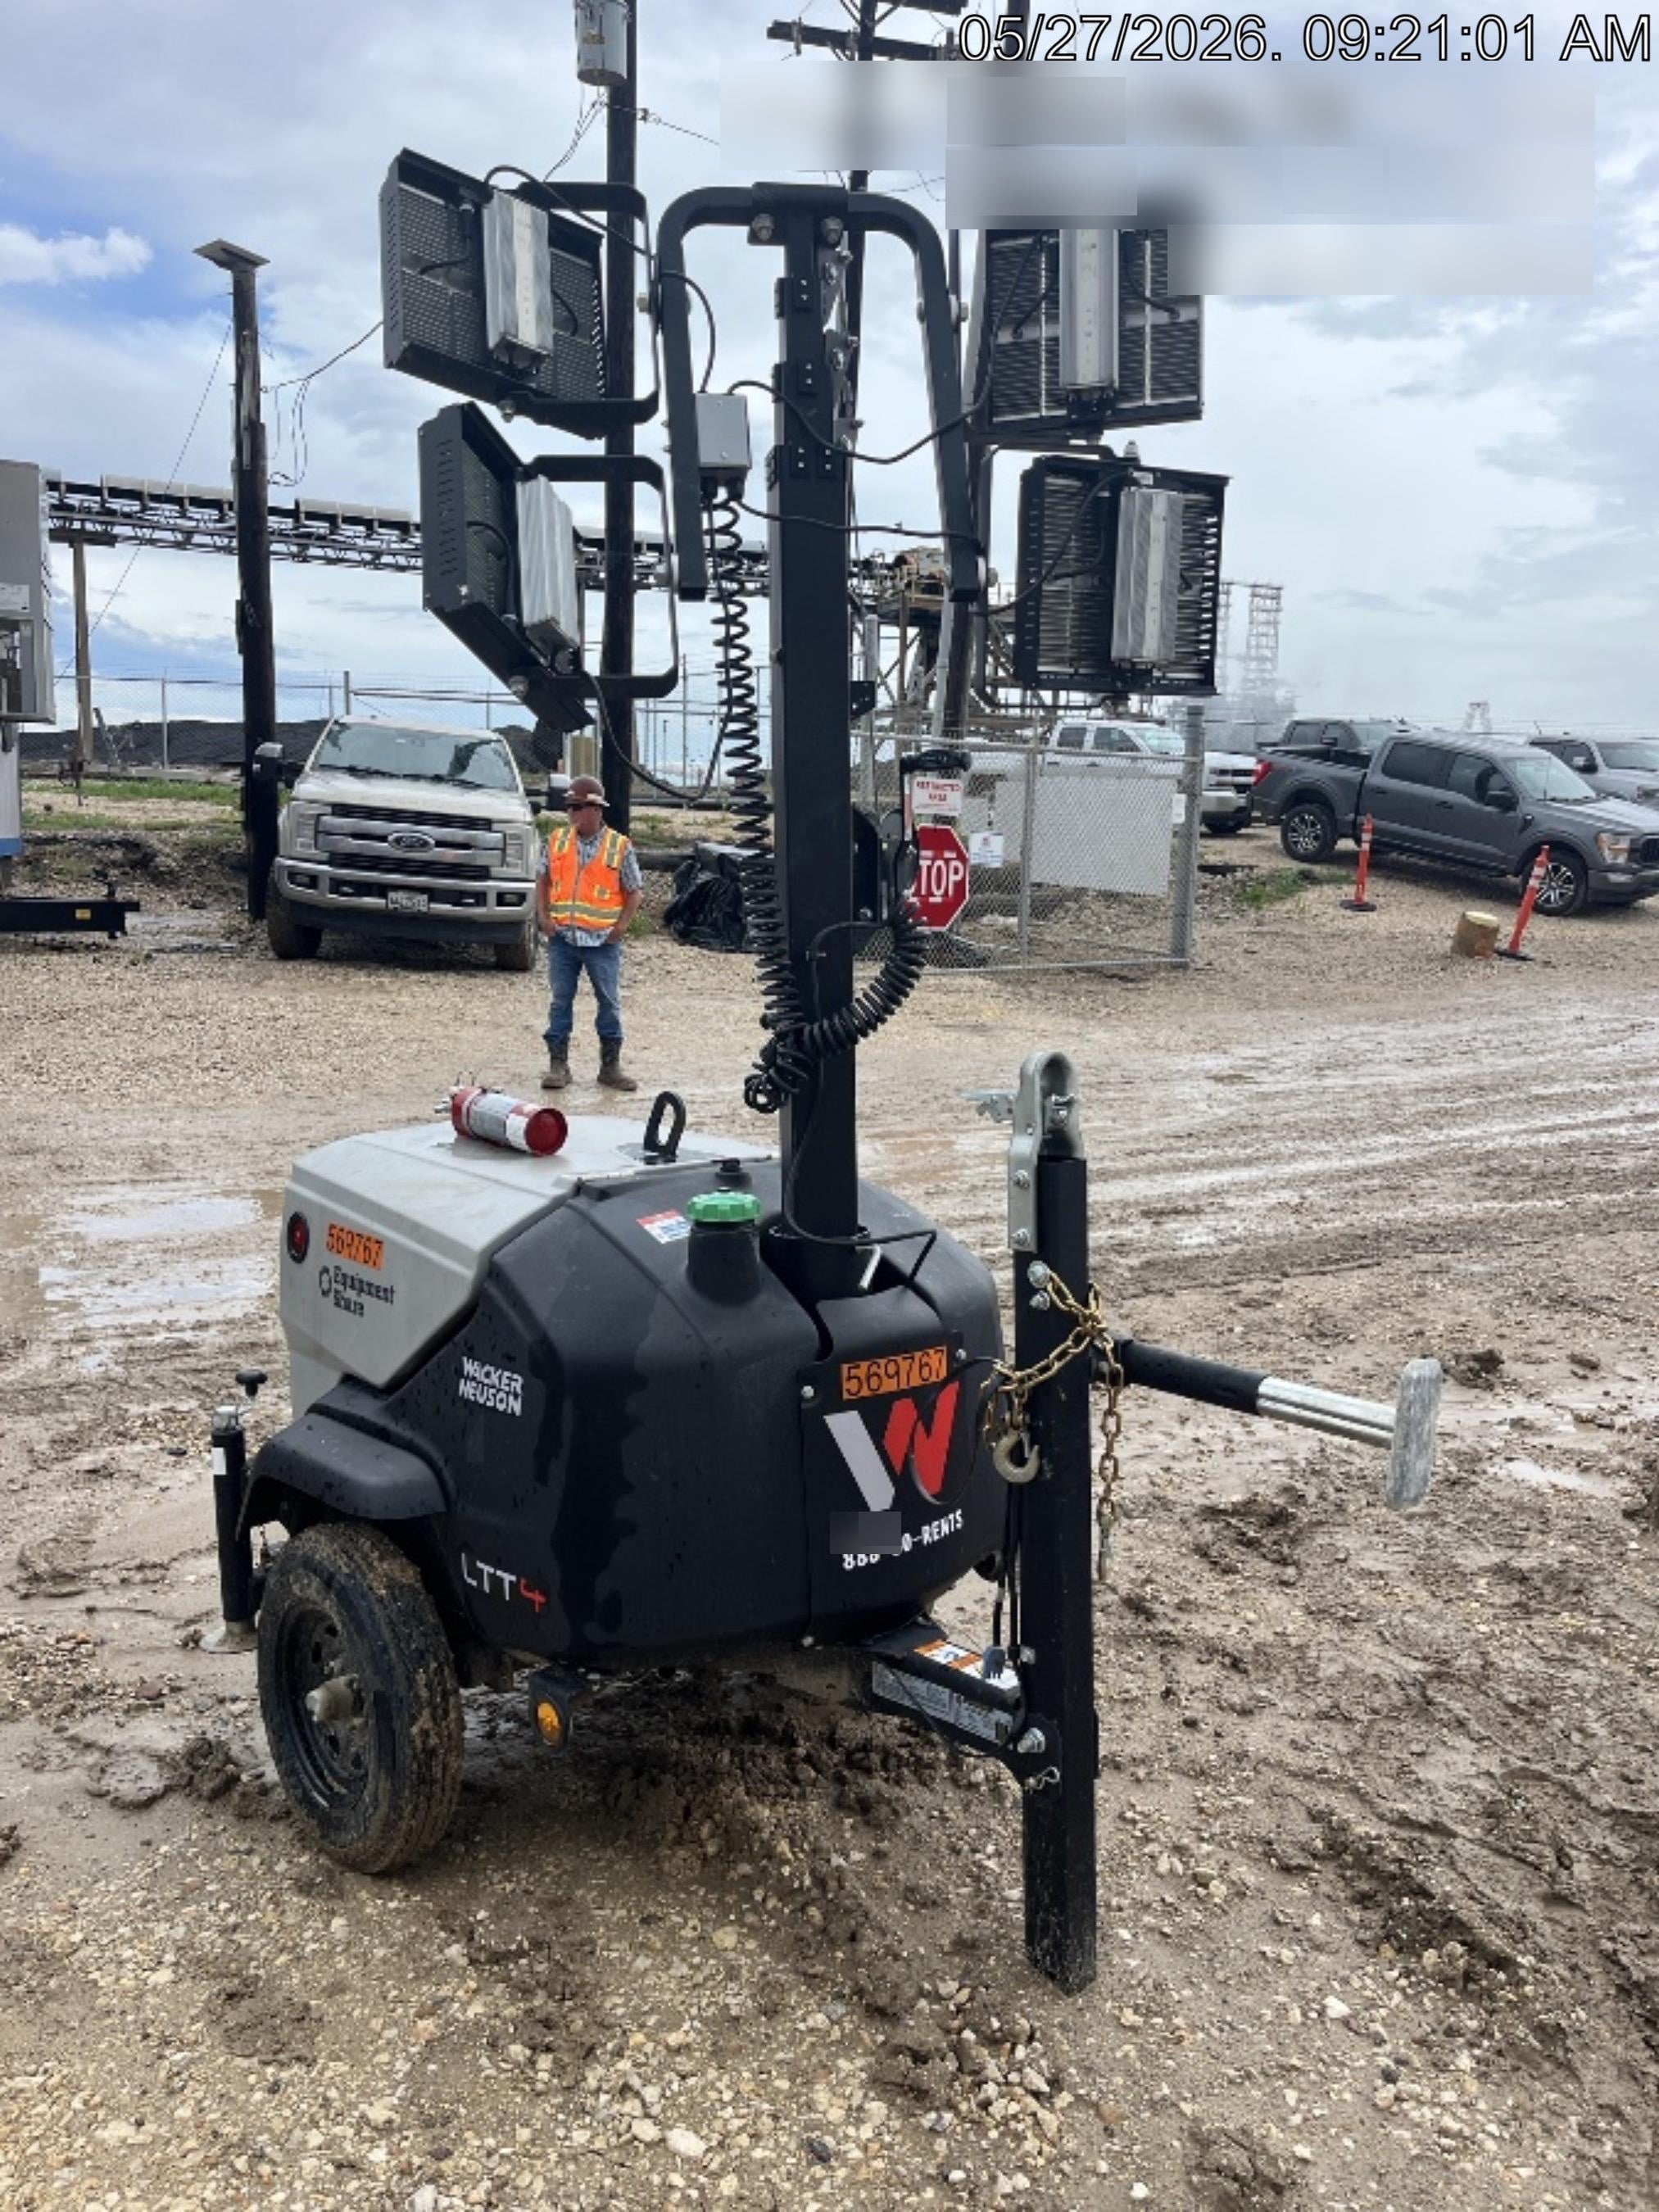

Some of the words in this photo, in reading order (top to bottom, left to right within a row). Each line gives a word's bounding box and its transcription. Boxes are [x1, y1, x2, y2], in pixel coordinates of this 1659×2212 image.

[913, 859, 965, 900] TOP
[325, 1222, 384, 1268] 569767
[460, 1355, 524, 1394] WACKER
[845, 1349, 945, 1398] 569767
[458, 1378, 523, 1417] NEUSON
[460, 1552, 547, 1614] LTT4
